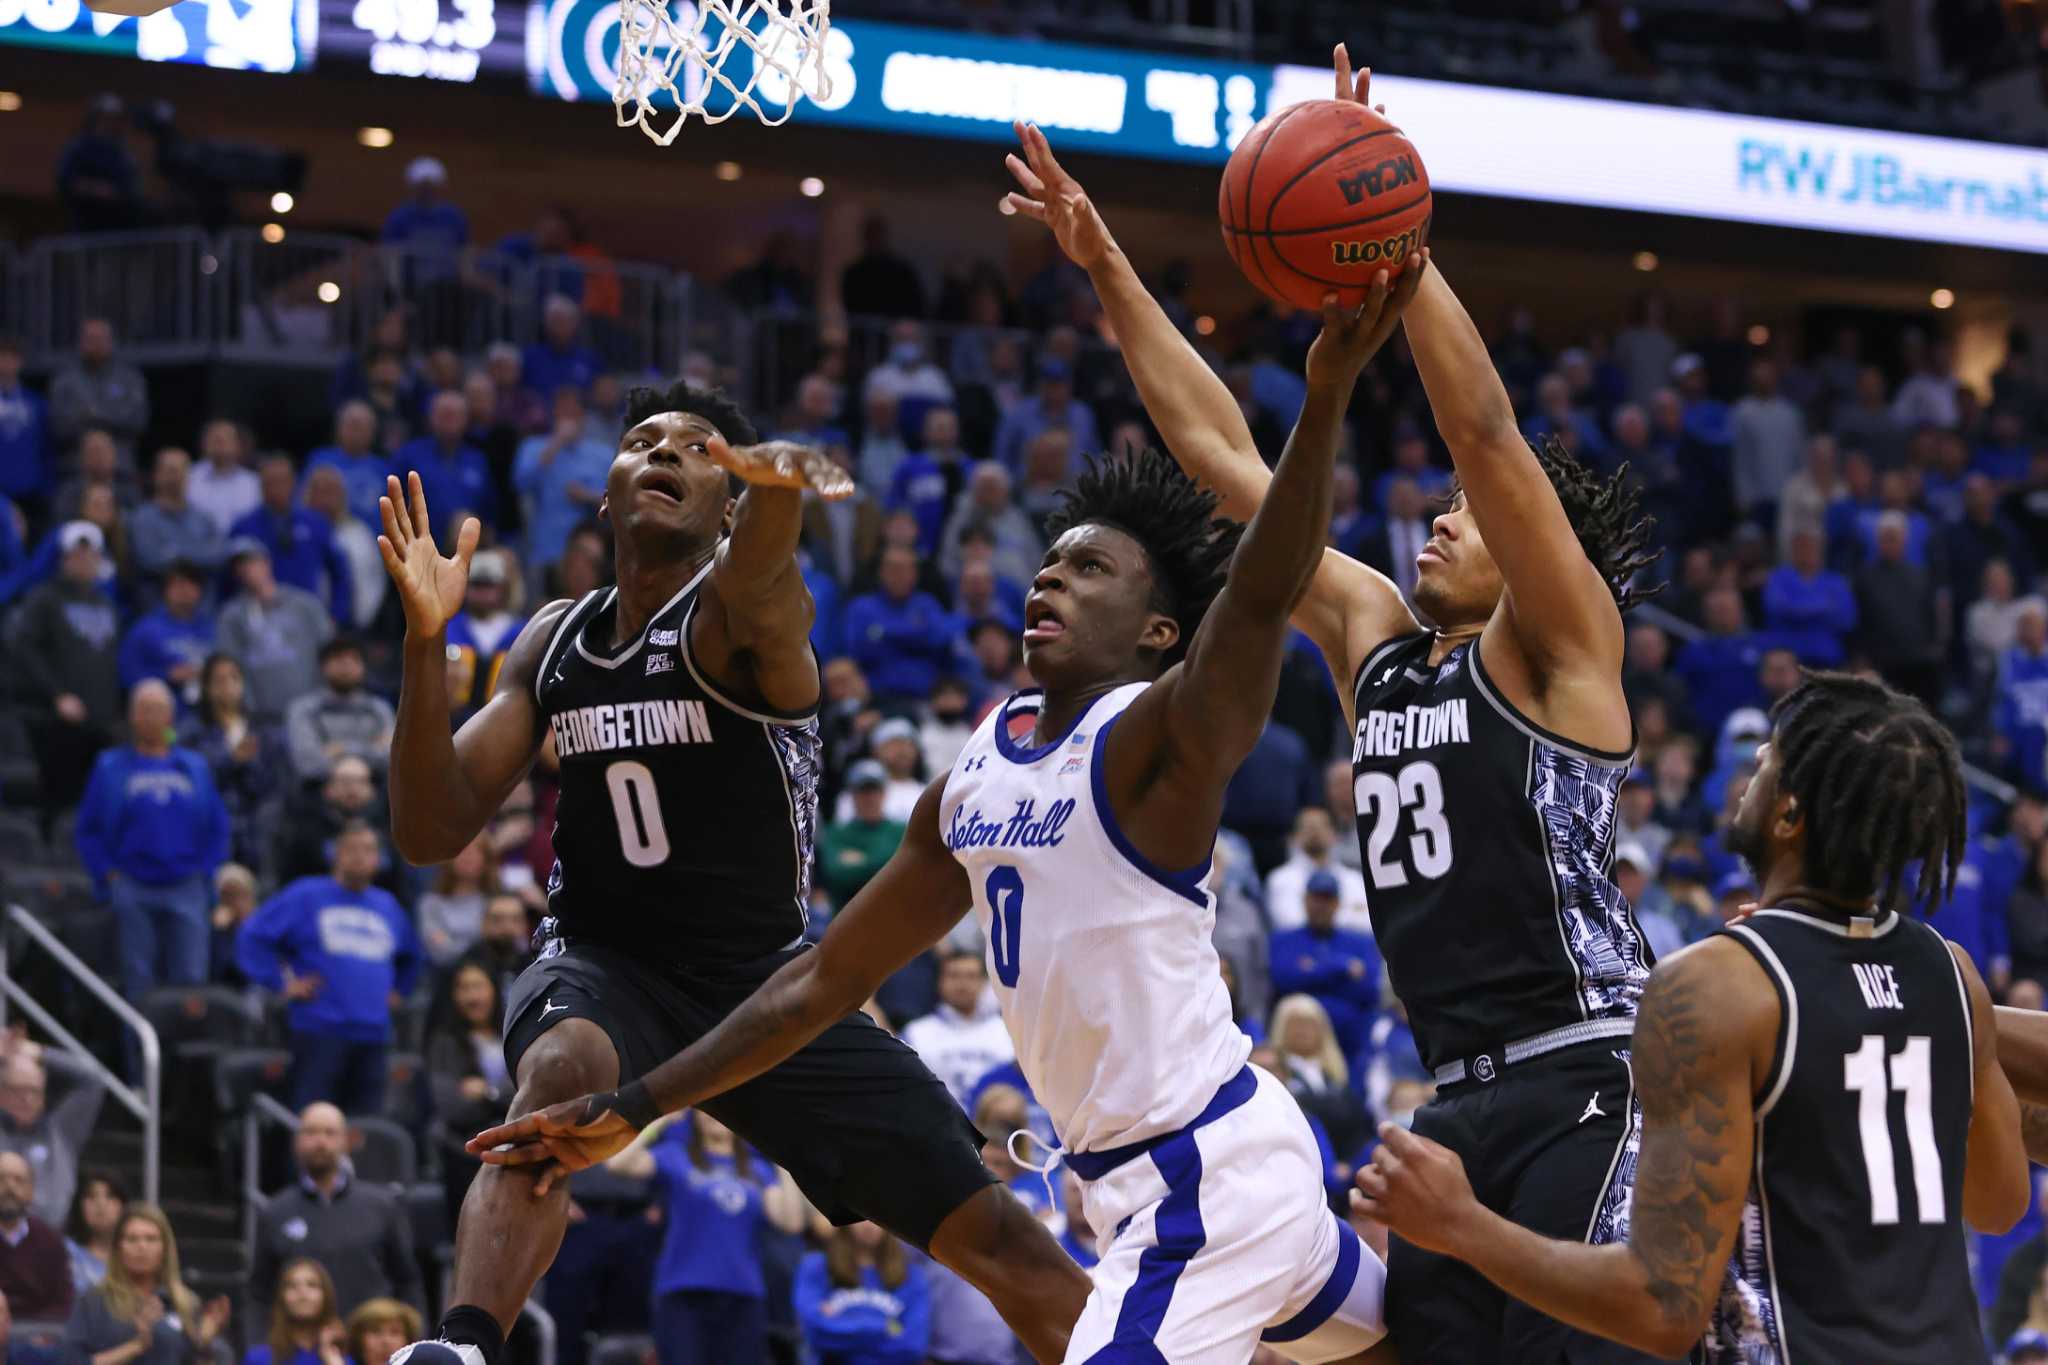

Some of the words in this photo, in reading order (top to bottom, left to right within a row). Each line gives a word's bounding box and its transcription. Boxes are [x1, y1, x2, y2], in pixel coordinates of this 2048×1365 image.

[1337, 153, 1418, 206] NCAA
[647, 653, 669, 663] BIG
[551, 700, 713, 758] GEORGETOWN
[605, 760, 671, 867] 0
[947, 804, 1003, 850] Seton
[1001, 798, 1076, 847] Hall
[1354, 760, 1453, 890] 23
[985, 865, 1024, 989] 0
[1852, 963, 1904, 1010] RICE
[1844, 1035, 1946, 1225] 11
